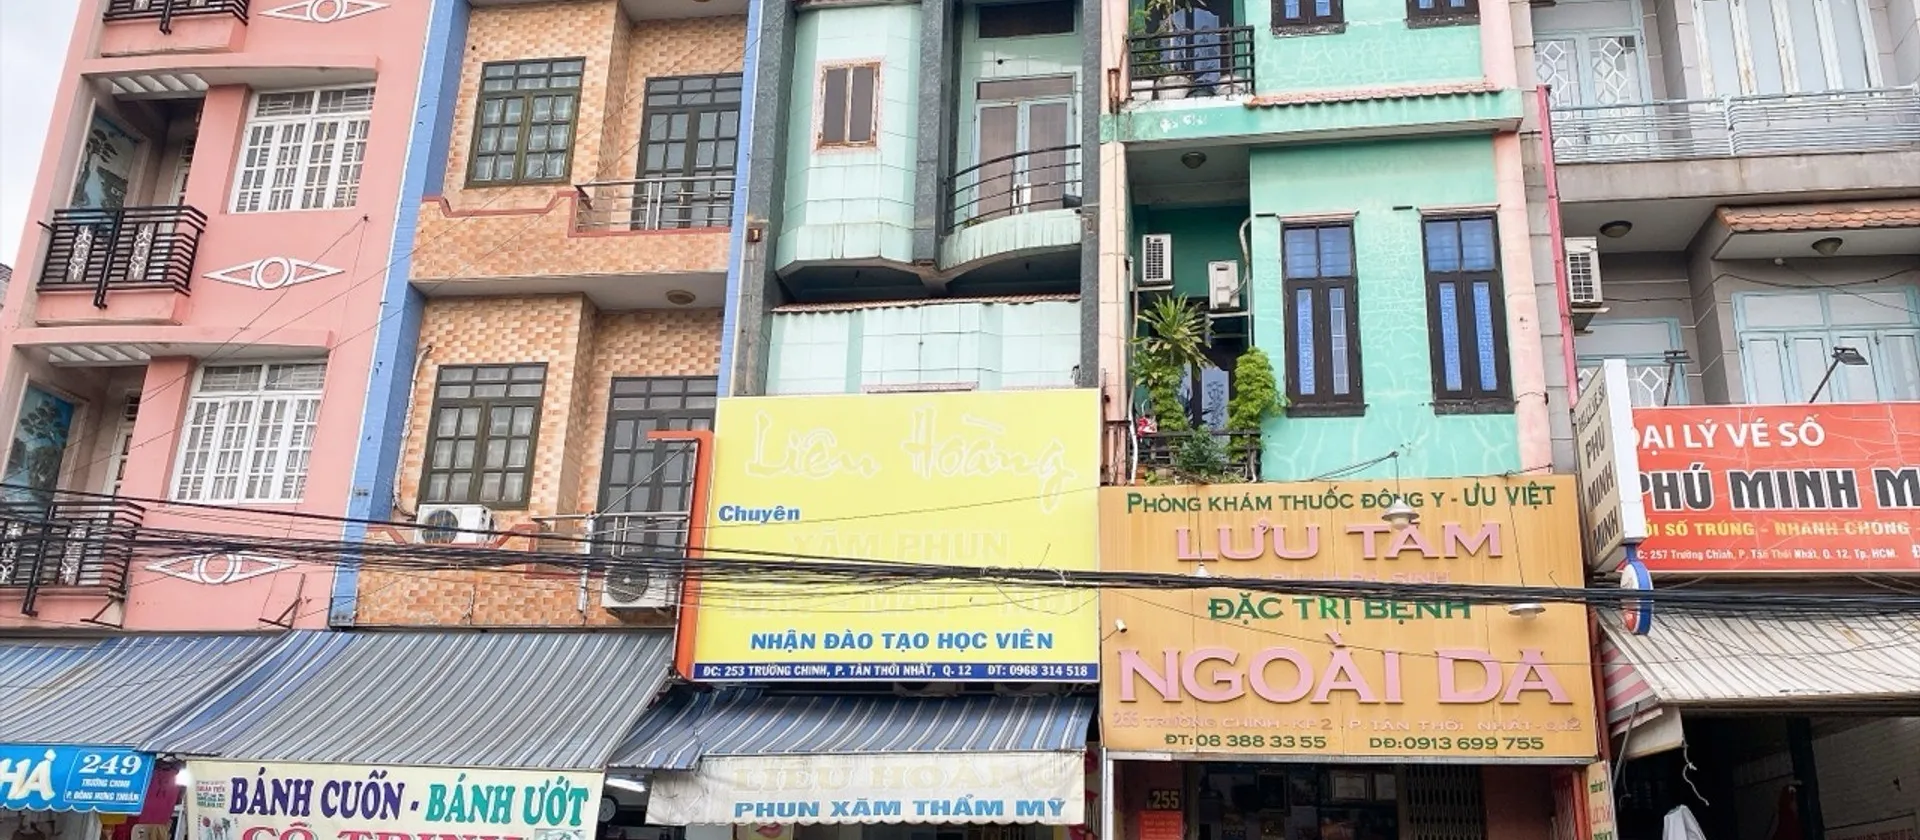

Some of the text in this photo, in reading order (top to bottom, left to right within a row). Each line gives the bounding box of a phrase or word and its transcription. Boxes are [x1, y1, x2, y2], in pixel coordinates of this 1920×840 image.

[1585, 416, 1605, 469] PHÚ
[1683, 419, 1719, 449] LÝ
[1725, 417, 1772, 449] VÉ
[1778, 413, 1827, 448] SỐ
[1208, 492, 1272, 511] KHÁM
[1279, 486, 1354, 510] THUỐC
[1431, 492, 1445, 508] Y
[1464, 482, 1496, 507] ƯU
[1505, 481, 1555, 510] VIỆT
[1588, 461, 1614, 513] MINH
[1727, 467, 1861, 510] MINH
[718, 505, 800, 524] Chuyên
[1665, 518, 1689, 536] SỐ
[1694, 518, 1756, 536] TRÚNG
[1774, 522, 1839, 536] NHANH
[1176, 518, 1320, 562] LƯU
[1592, 506, 1619, 557] MINH
[896, 531, 1010, 562] PHUN
[1636, 549, 1648, 560] C:
[1650, 549, 1668, 559] 257
[1207, 592, 1283, 625] ĐẶC
[1292, 596, 1352, 626] TRỊ
[750, 629, 1054, 652] NHẬN ĐÀO TẠO HỌC VIÊN
[703, 665, 722, 677] ĐC:
[724, 665, 745, 677] 253
[835, 665, 845, 677] P.
[850, 664, 871, 676] TÂN
[943, 665, 954, 677] Q.
[958, 665, 972, 676] 12
[987, 665, 1087, 677] ĐT: 0968 314 518
[1116, 632, 1574, 706] NGOÀI DA
[1222, 715, 1280, 729] CHINH
[1226, 735, 1265, 748] 388
[1270, 735, 1296, 748] 33
[1300, 735, 1326, 749] 55
[1457, 737, 1498, 750] 699
[1503, 737, 1544, 750] 755
[78, 754, 143, 775] 249
[229, 767, 314, 817] BÁNH
[320, 770, 405, 820] CUỐN
[410, 801, 419, 811] -
[425, 773, 515, 824] BÁNH
[523, 775, 589, 827] ƯỚT
[735, 793, 1067, 819] PHUN XĂM THẨM MỸ
[1152, 791, 1179, 809] 255
